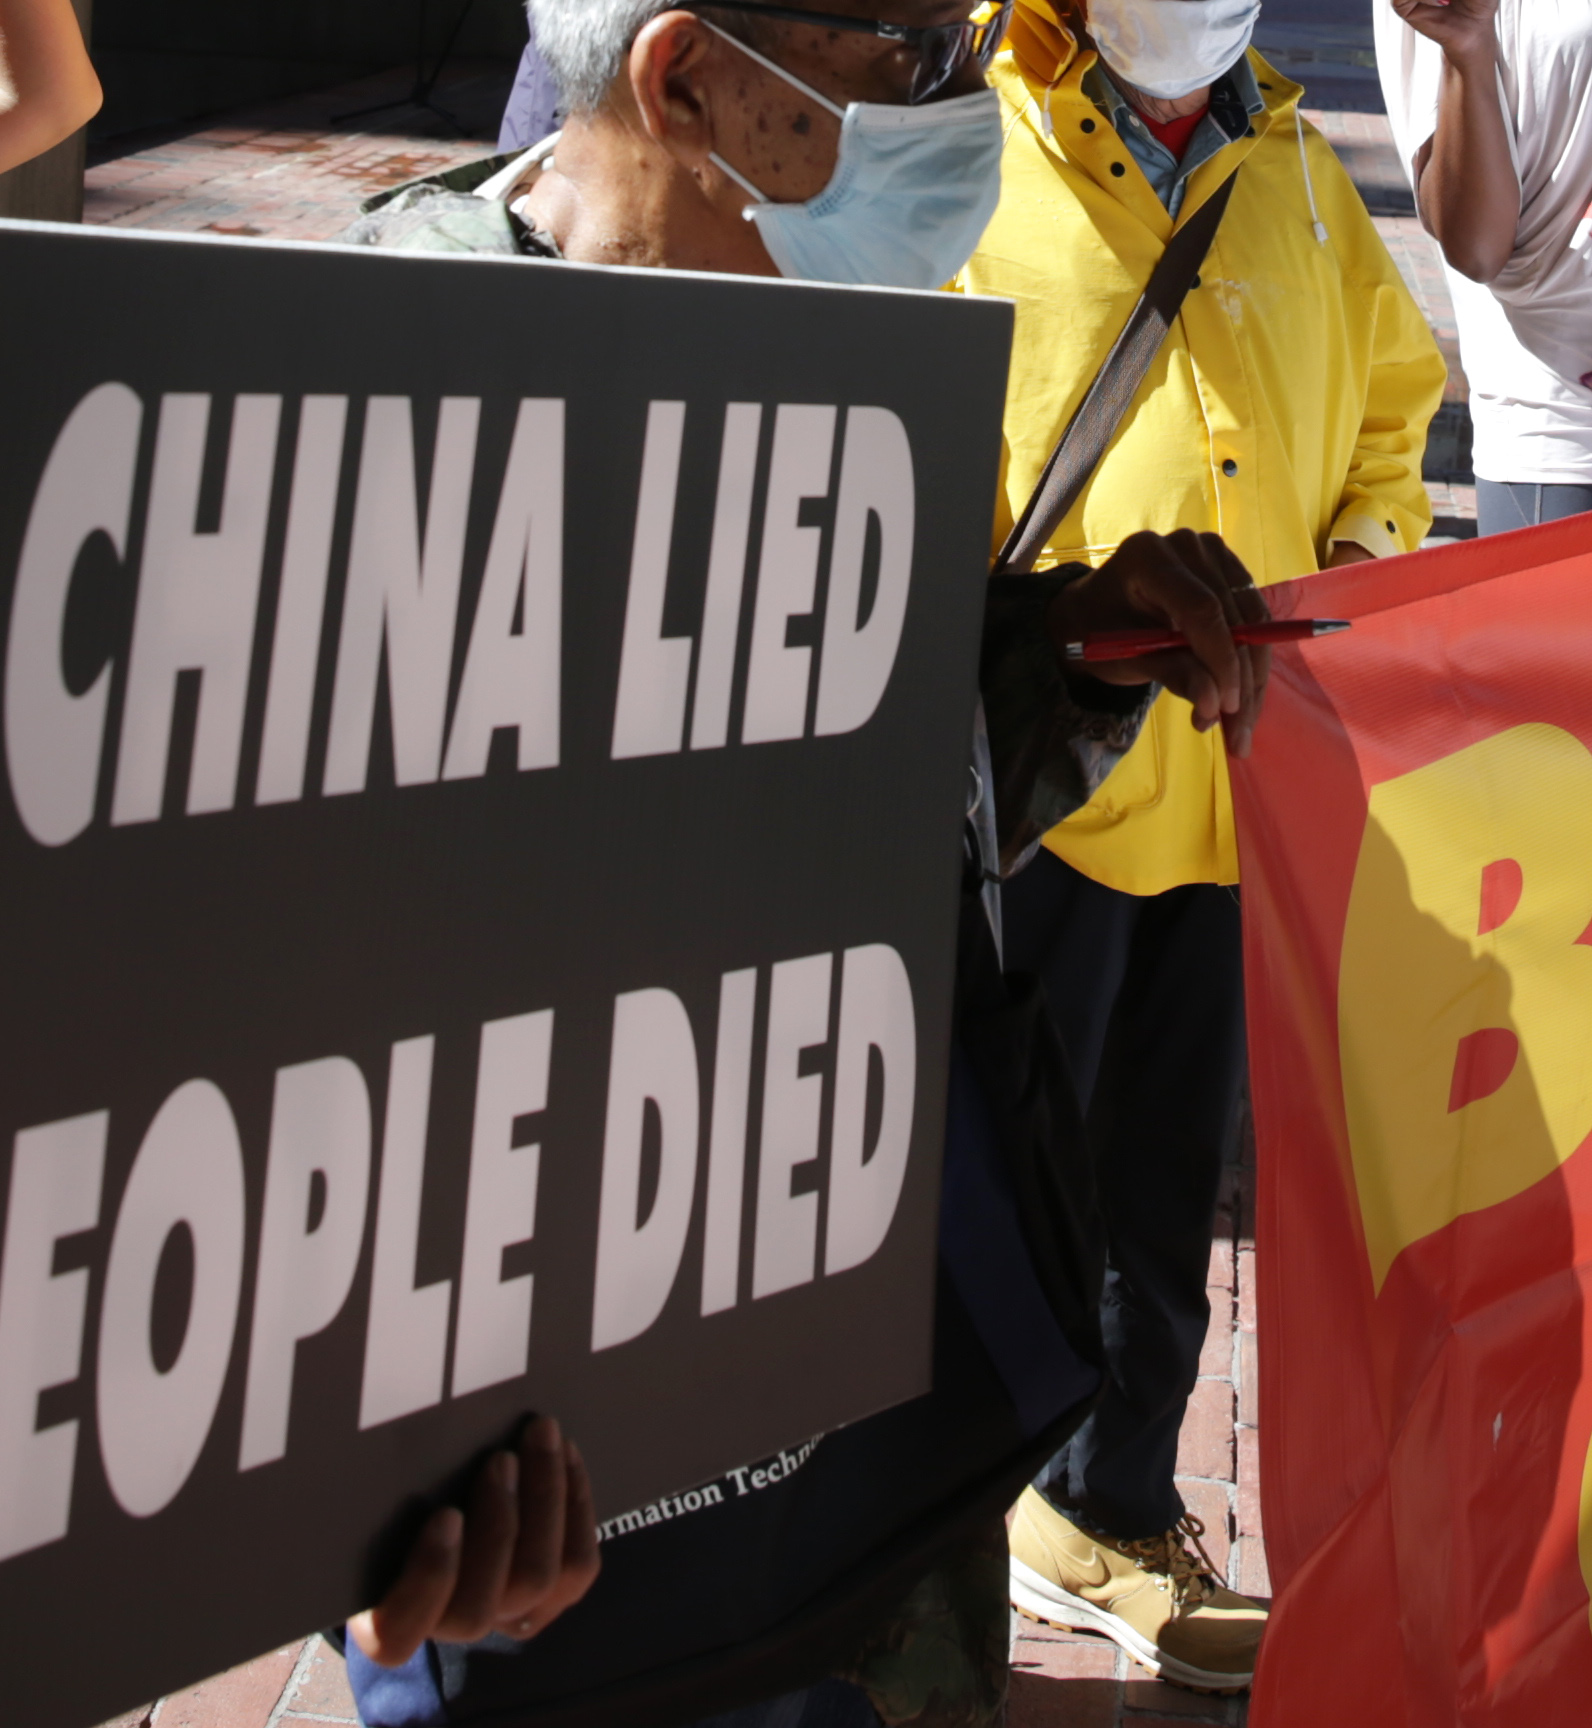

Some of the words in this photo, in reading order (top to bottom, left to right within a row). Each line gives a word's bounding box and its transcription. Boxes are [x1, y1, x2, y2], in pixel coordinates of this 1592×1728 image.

[2, 379, 566, 848] CHINA
[610, 400, 917, 761] LIED
[590, 942, 918, 1353] DIED
